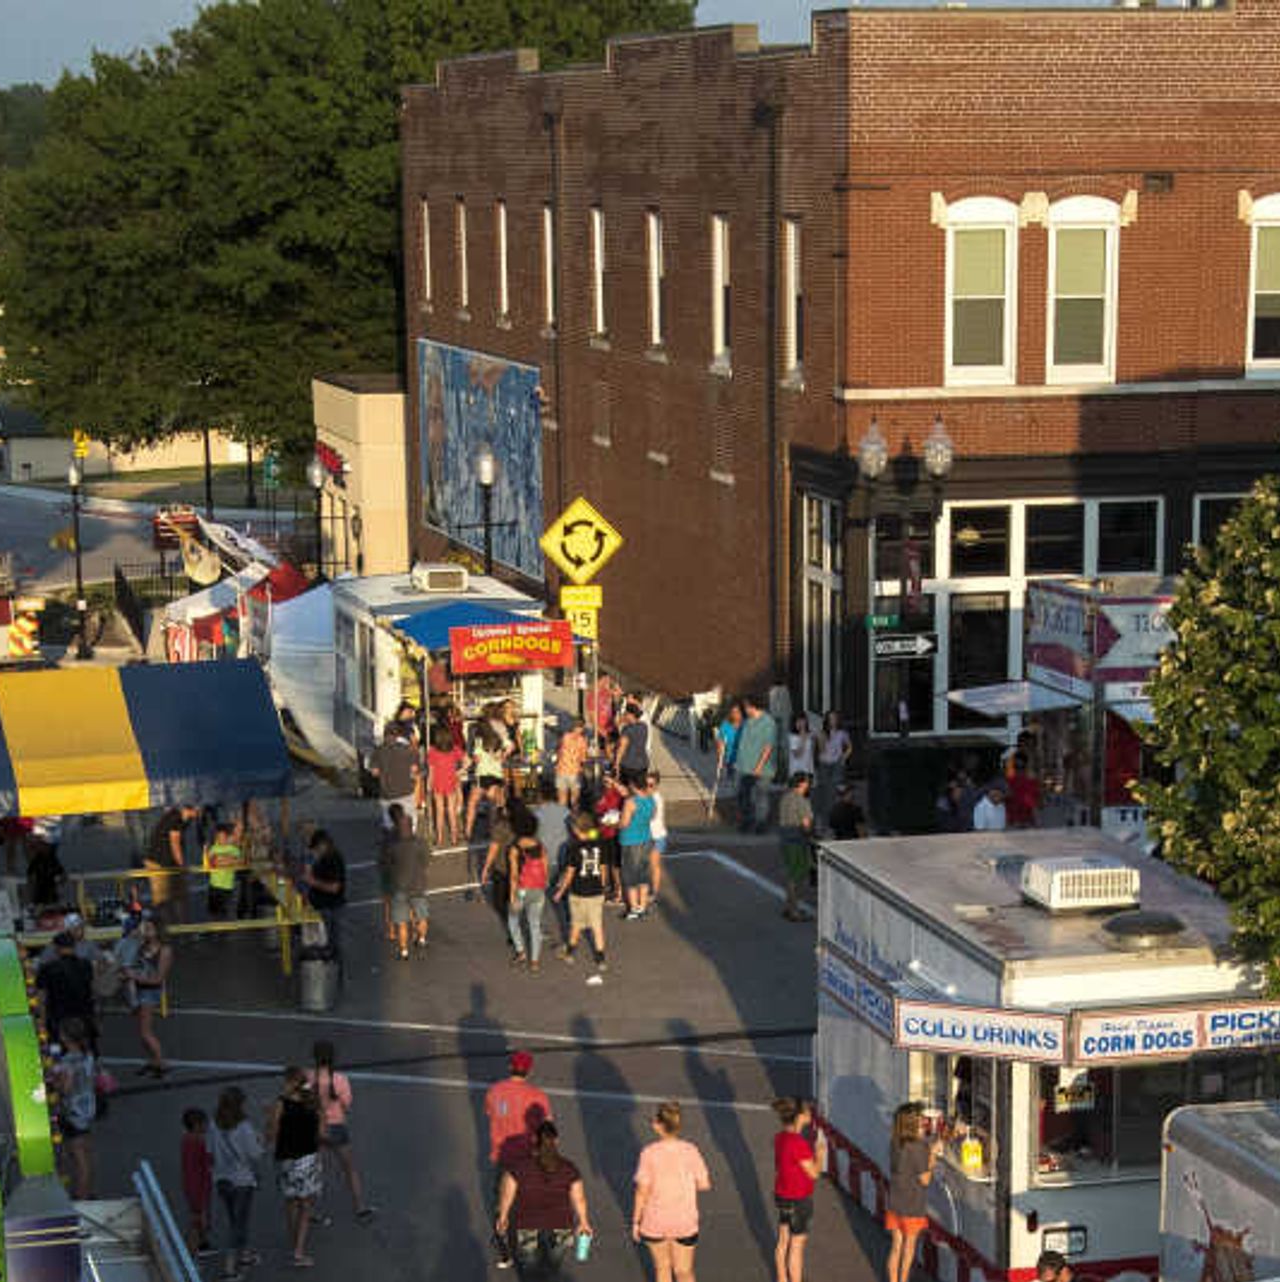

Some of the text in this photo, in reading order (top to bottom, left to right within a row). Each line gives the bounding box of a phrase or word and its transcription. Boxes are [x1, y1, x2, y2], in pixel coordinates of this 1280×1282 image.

[573, 612, 591, 627] 15
[463, 635, 562, 661] CORNDOGS
[580, 847, 600, 876] H
[904, 1017, 1058, 1050] COLD DRINKS
[1084, 1030, 1193, 1055] CORN DOGS
